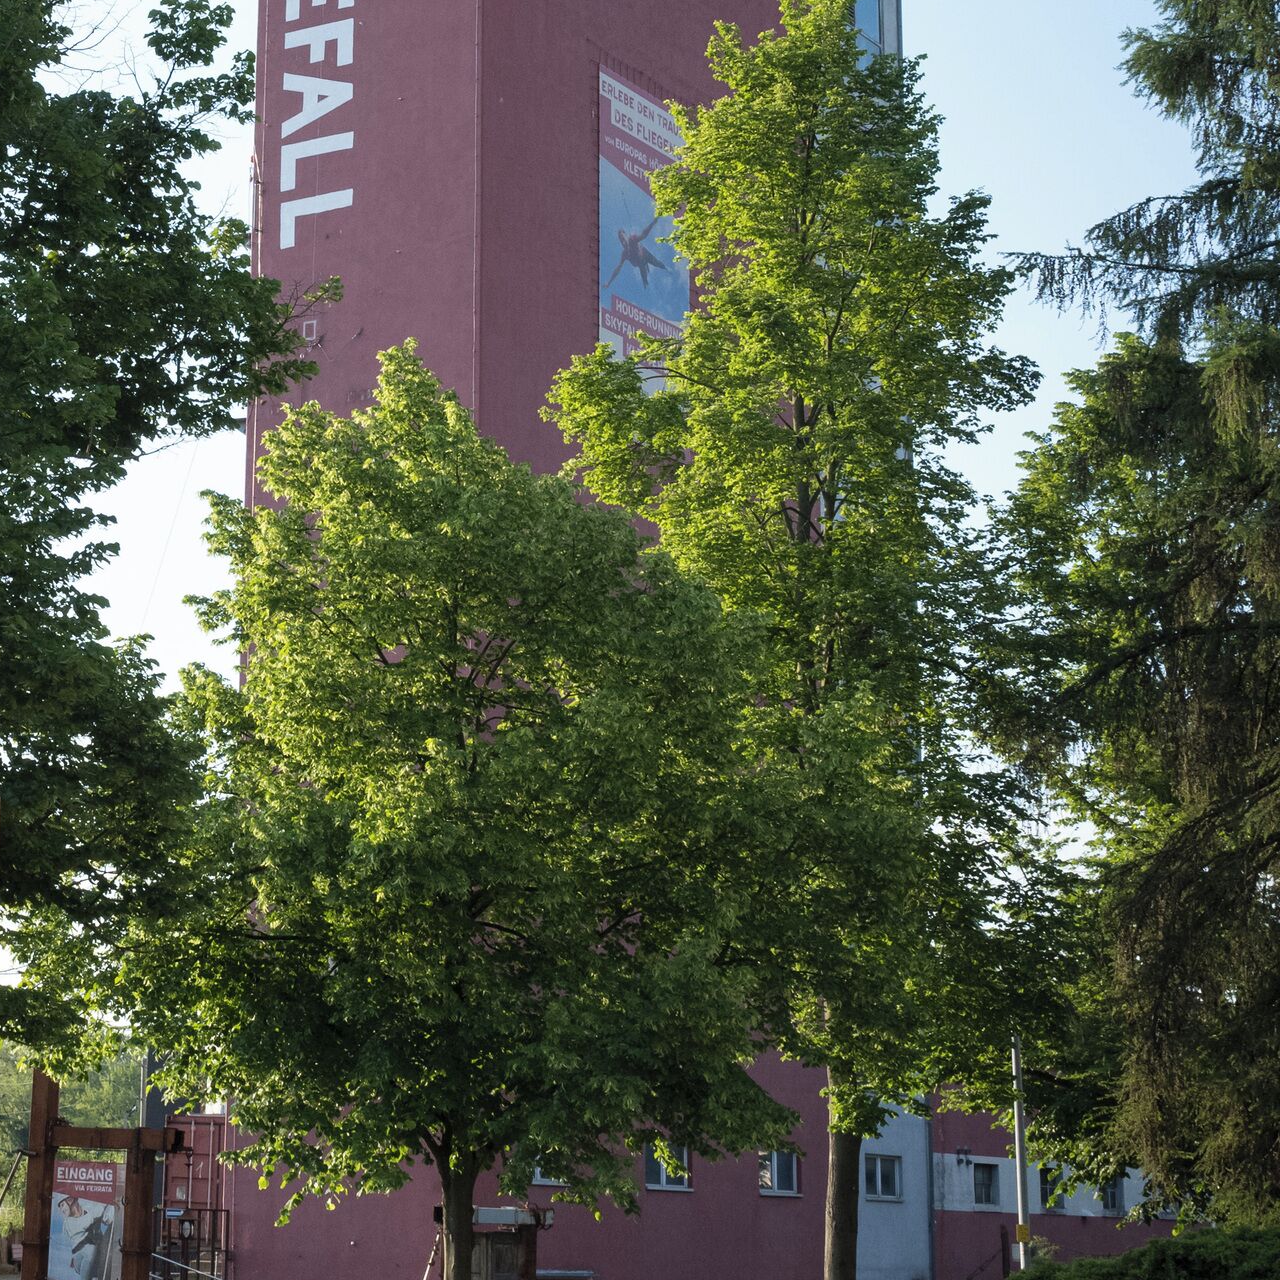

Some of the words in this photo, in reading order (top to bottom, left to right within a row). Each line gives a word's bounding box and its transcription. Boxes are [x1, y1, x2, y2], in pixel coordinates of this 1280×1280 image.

[601, 80, 634, 109] ERLEBE
[637, 103, 655, 122] DEN
[657, 114, 682, 137] TRAU
[614, 109, 634, 132] DES
[615, 138, 647, 165] EUROPAS
[649, 157, 663, 171] HÖ
[615, 299, 681, 342] HOUSE-RUNNIN
[57, 1166, 113, 1181] EINGANG
